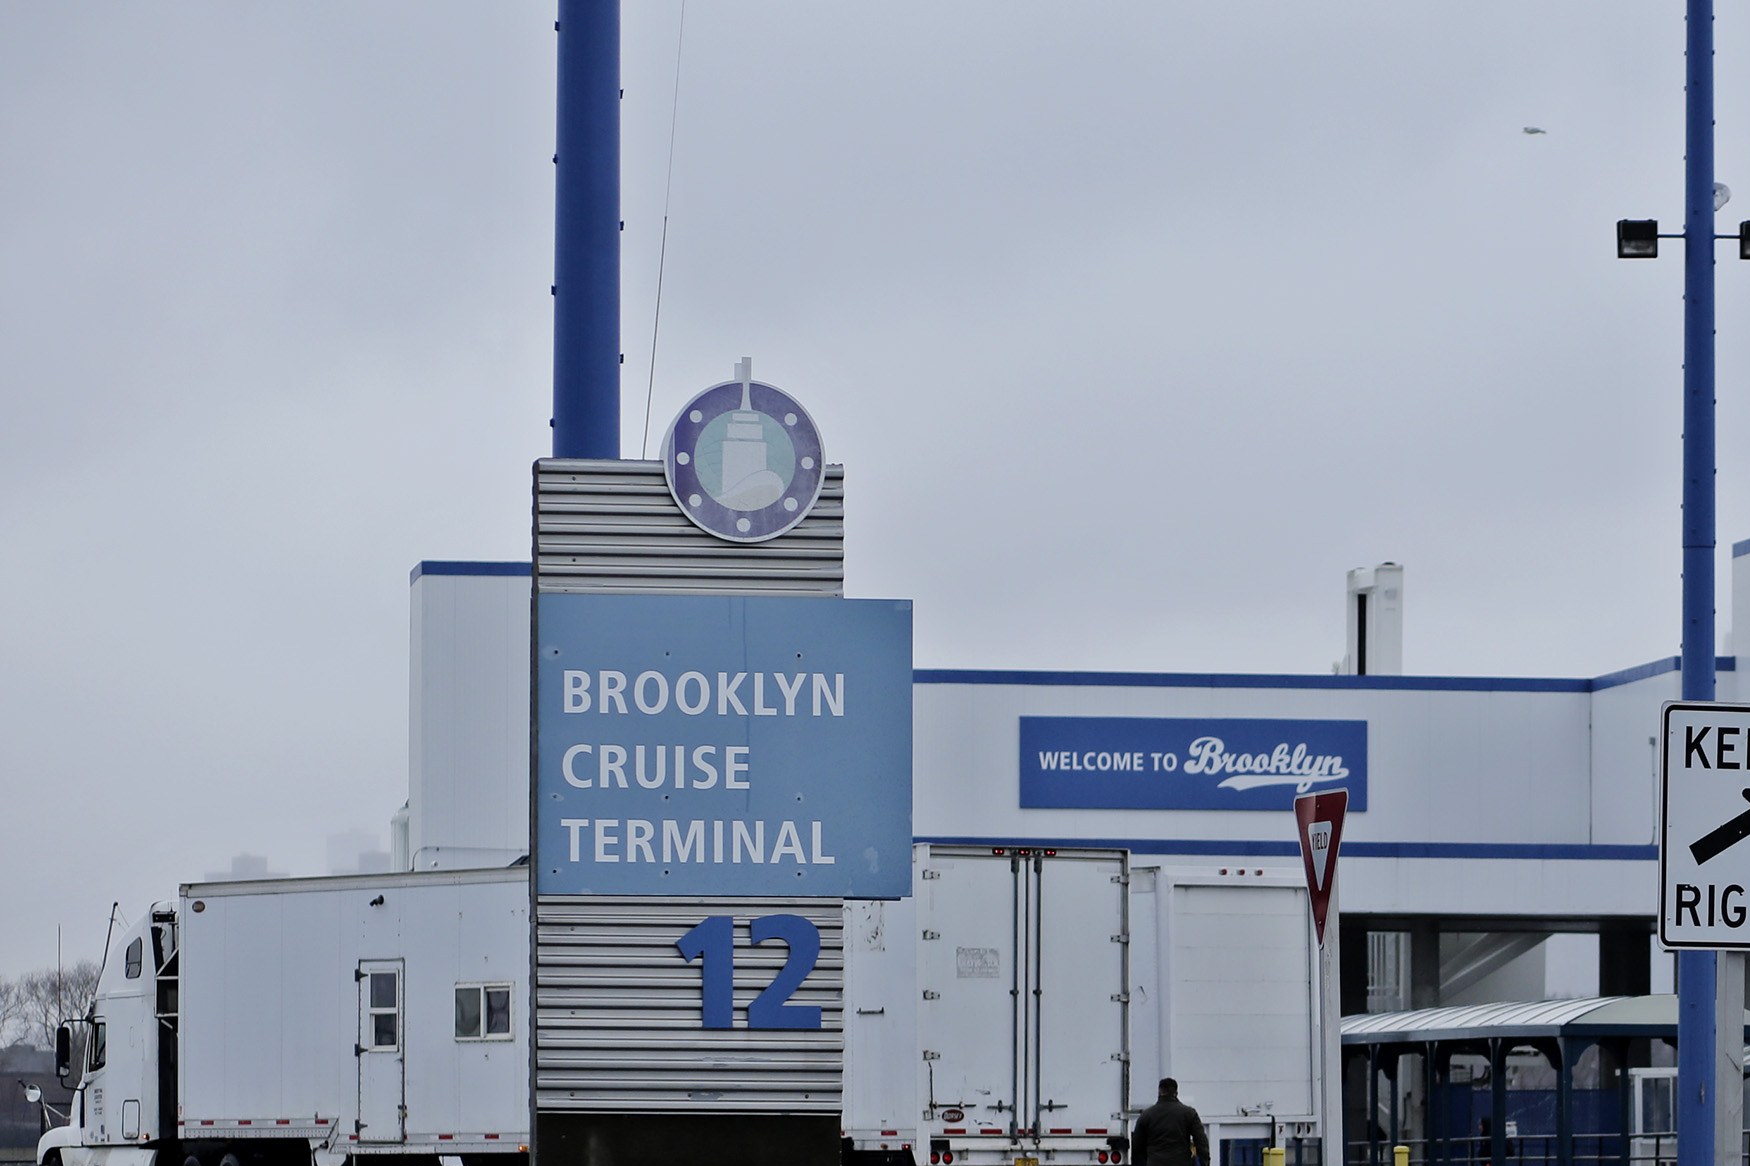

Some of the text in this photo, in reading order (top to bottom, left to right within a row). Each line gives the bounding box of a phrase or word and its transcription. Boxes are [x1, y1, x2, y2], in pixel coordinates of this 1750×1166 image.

[561, 669, 845, 718] BROOKLYN
[561, 743, 751, 790] CRUISE
[1038, 736, 1349, 793] WELCOME TO Brooklyn
[561, 818, 836, 866] TERMINAL
[1311, 832, 1328, 850] YIELD
[675, 913, 822, 1029] 12
